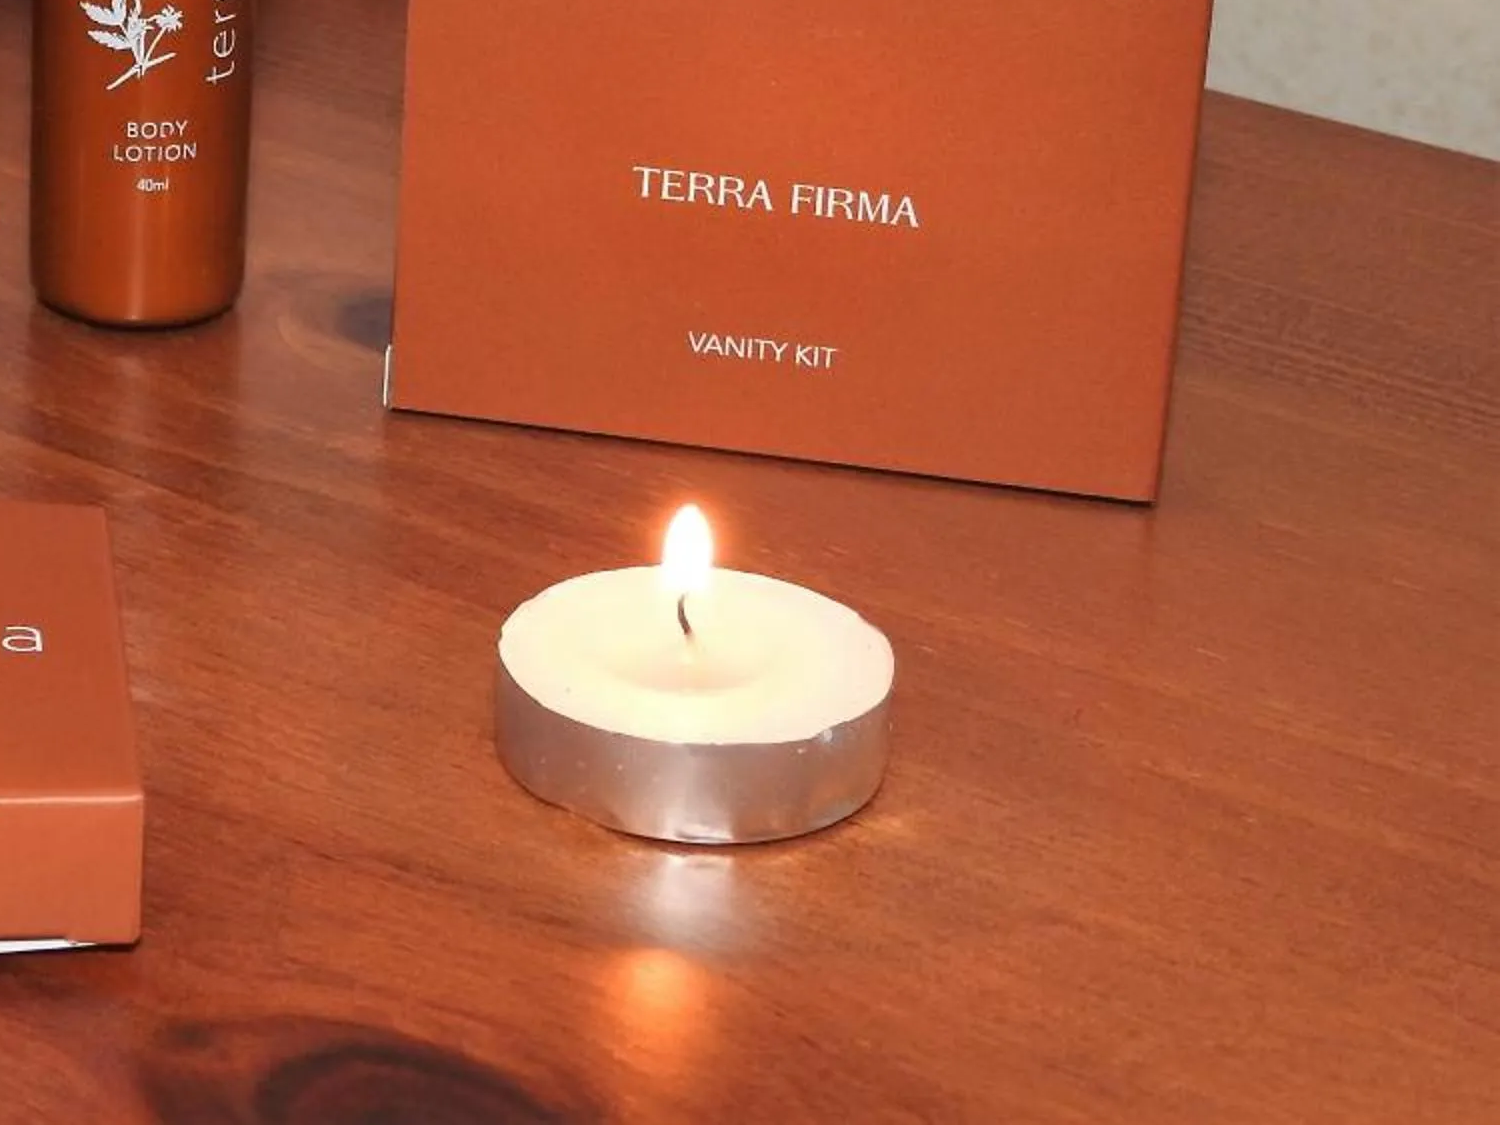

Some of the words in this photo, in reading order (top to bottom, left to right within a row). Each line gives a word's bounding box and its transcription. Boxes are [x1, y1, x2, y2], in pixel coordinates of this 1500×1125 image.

[126, 119, 188, 140] BODY
[113, 141, 197, 163] LOTION
[136, 177, 169, 193] 40ml
[632, 166, 774, 212] TERRA
[791, 183, 920, 228] FIRMA
[687, 330, 789, 363] VANITY
[795, 344, 838, 369] KIT
